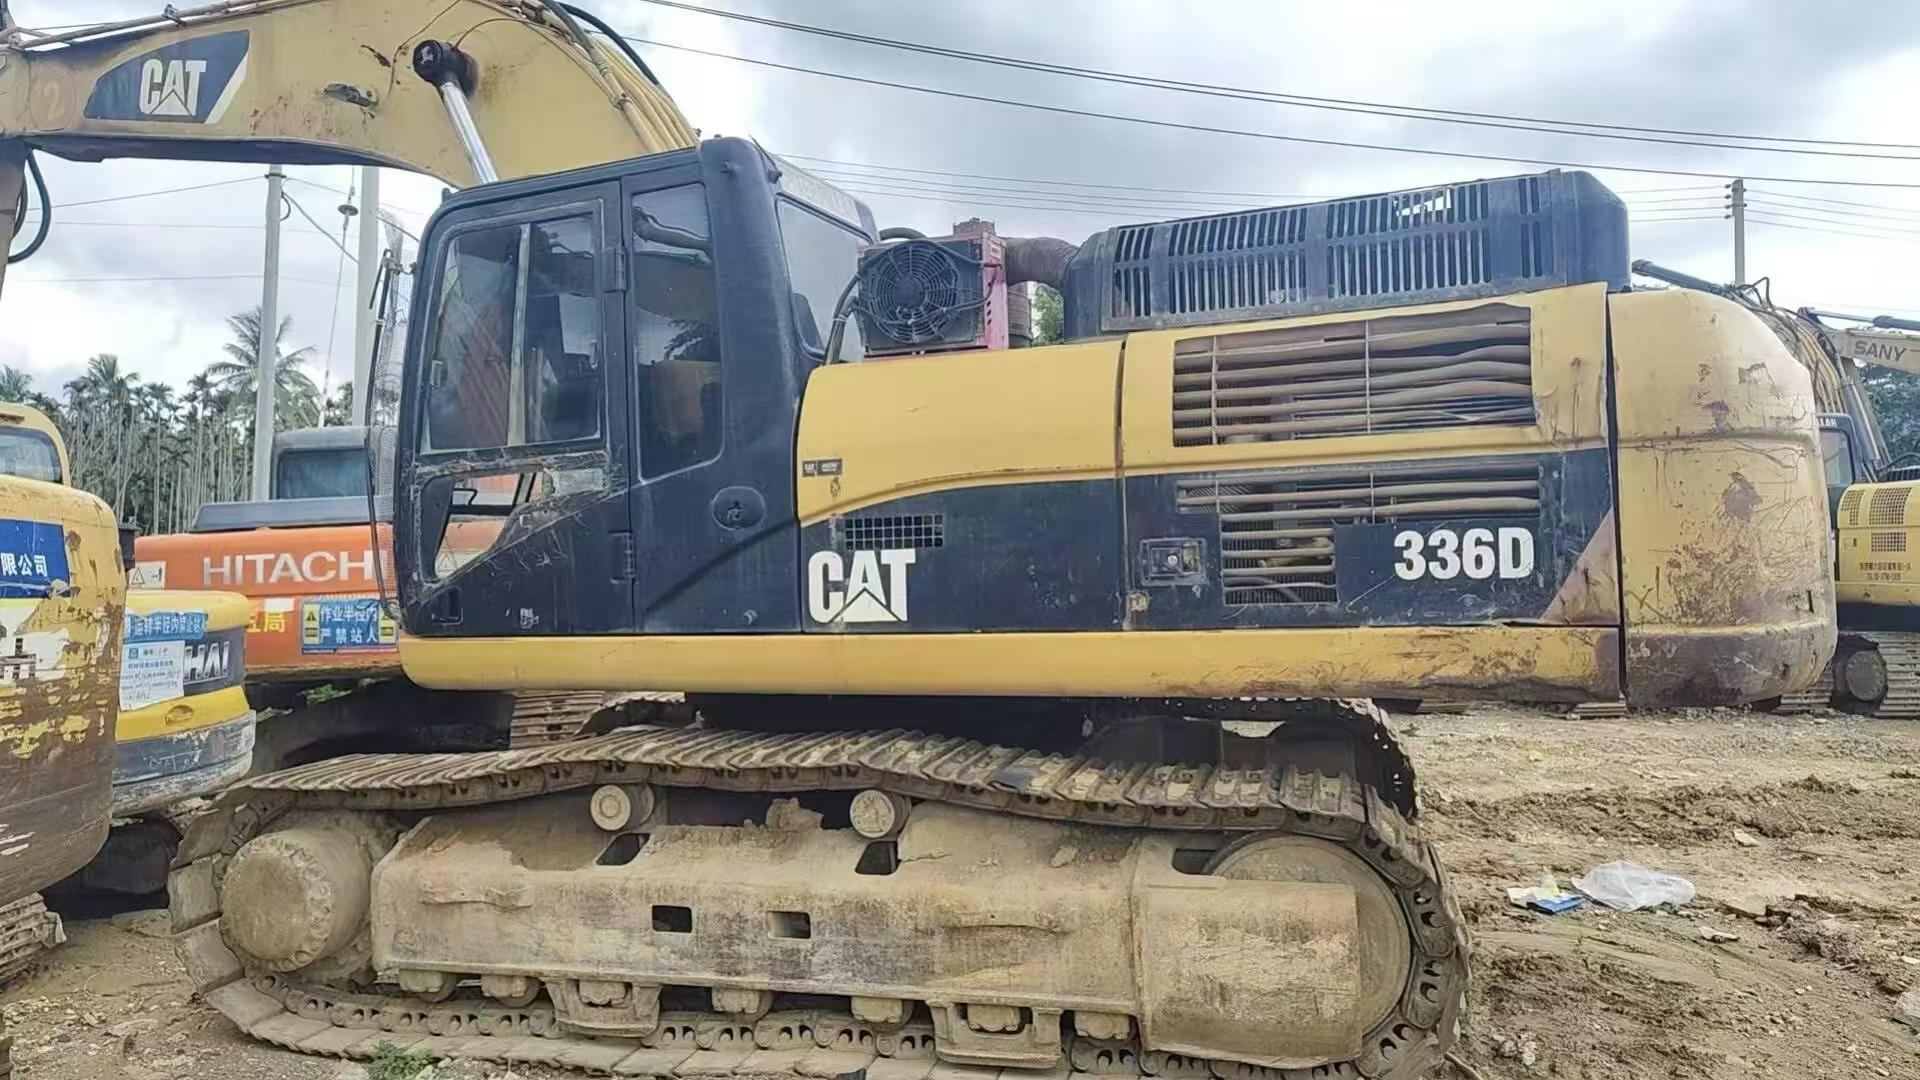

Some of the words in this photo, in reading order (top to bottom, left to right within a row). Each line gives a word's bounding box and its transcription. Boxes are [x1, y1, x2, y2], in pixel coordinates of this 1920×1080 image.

[140, 60, 206, 115] CAT
[1854, 340, 1906, 361] SANY
[1394, 527, 1534, 580] 336D
[808, 549, 917, 623] CAT
[320, 604, 378, 624] 作业半径内
[320, 625, 378, 644] 严禁站人
